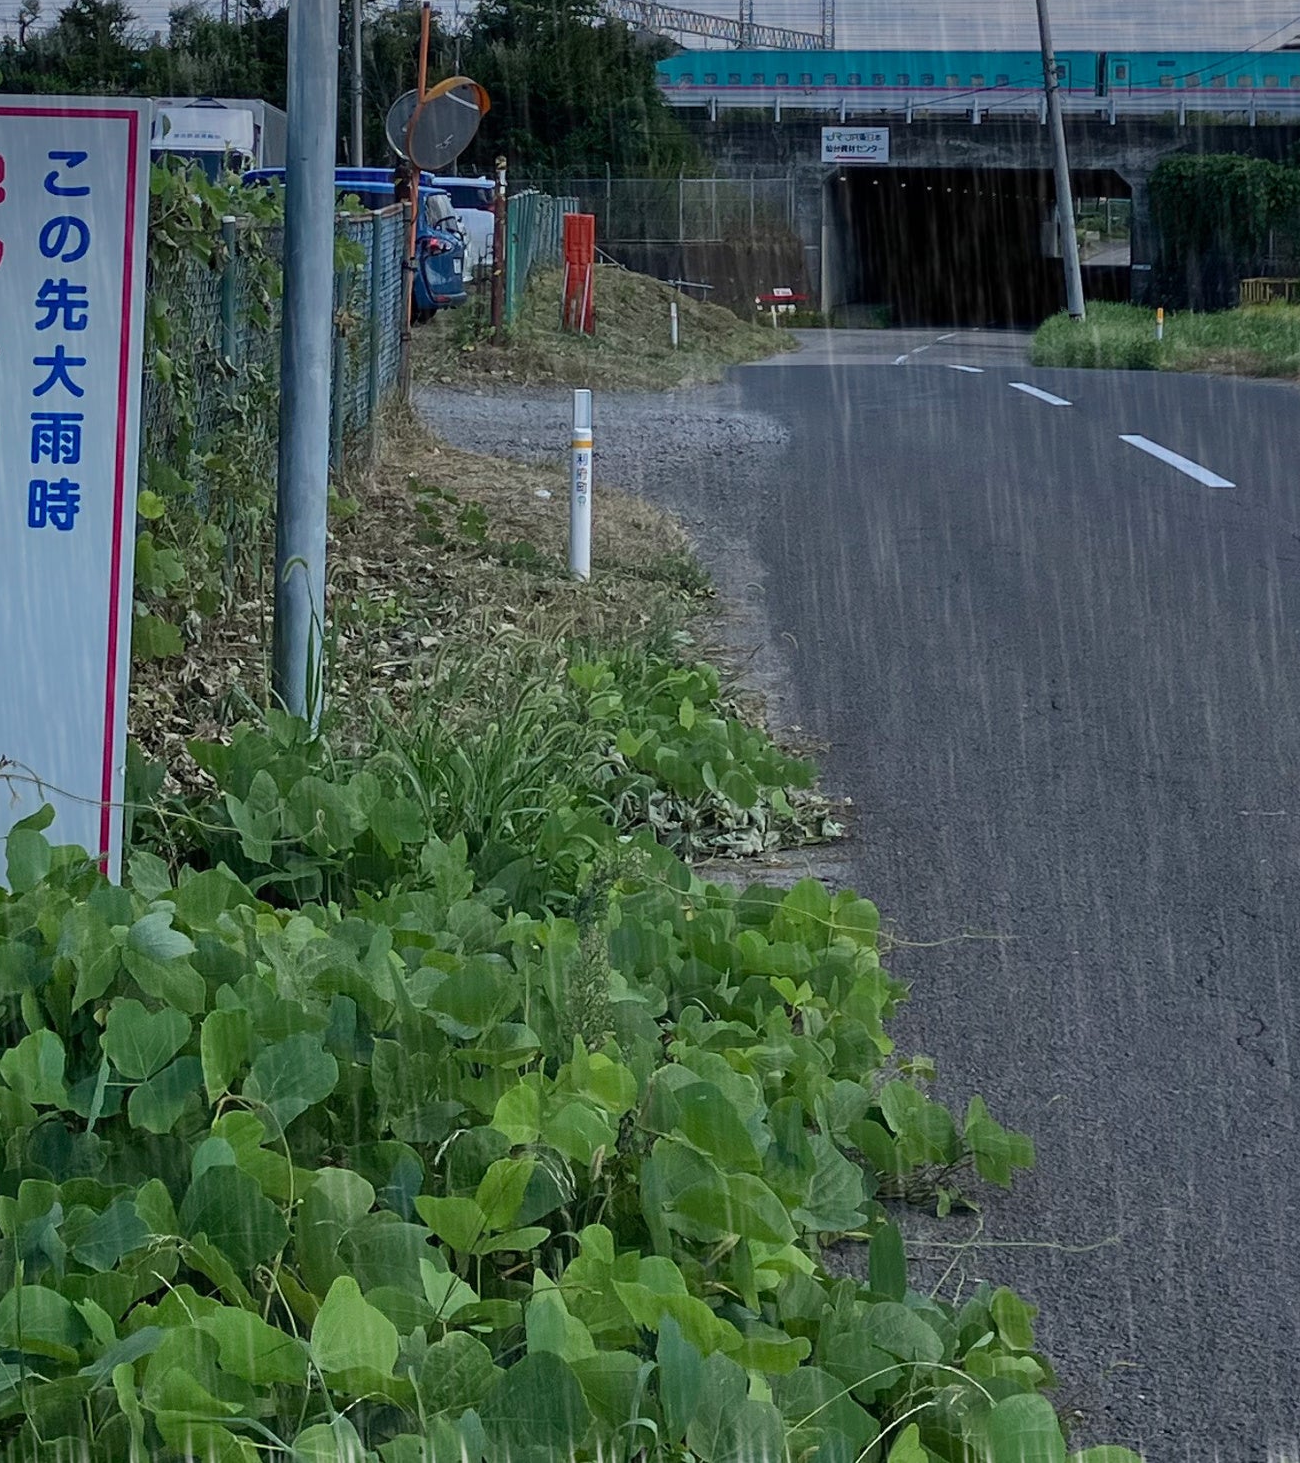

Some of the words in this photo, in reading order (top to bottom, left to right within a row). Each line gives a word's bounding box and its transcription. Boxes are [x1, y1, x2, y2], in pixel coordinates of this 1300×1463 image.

[27, 150, 91, 532] この先大雨時
